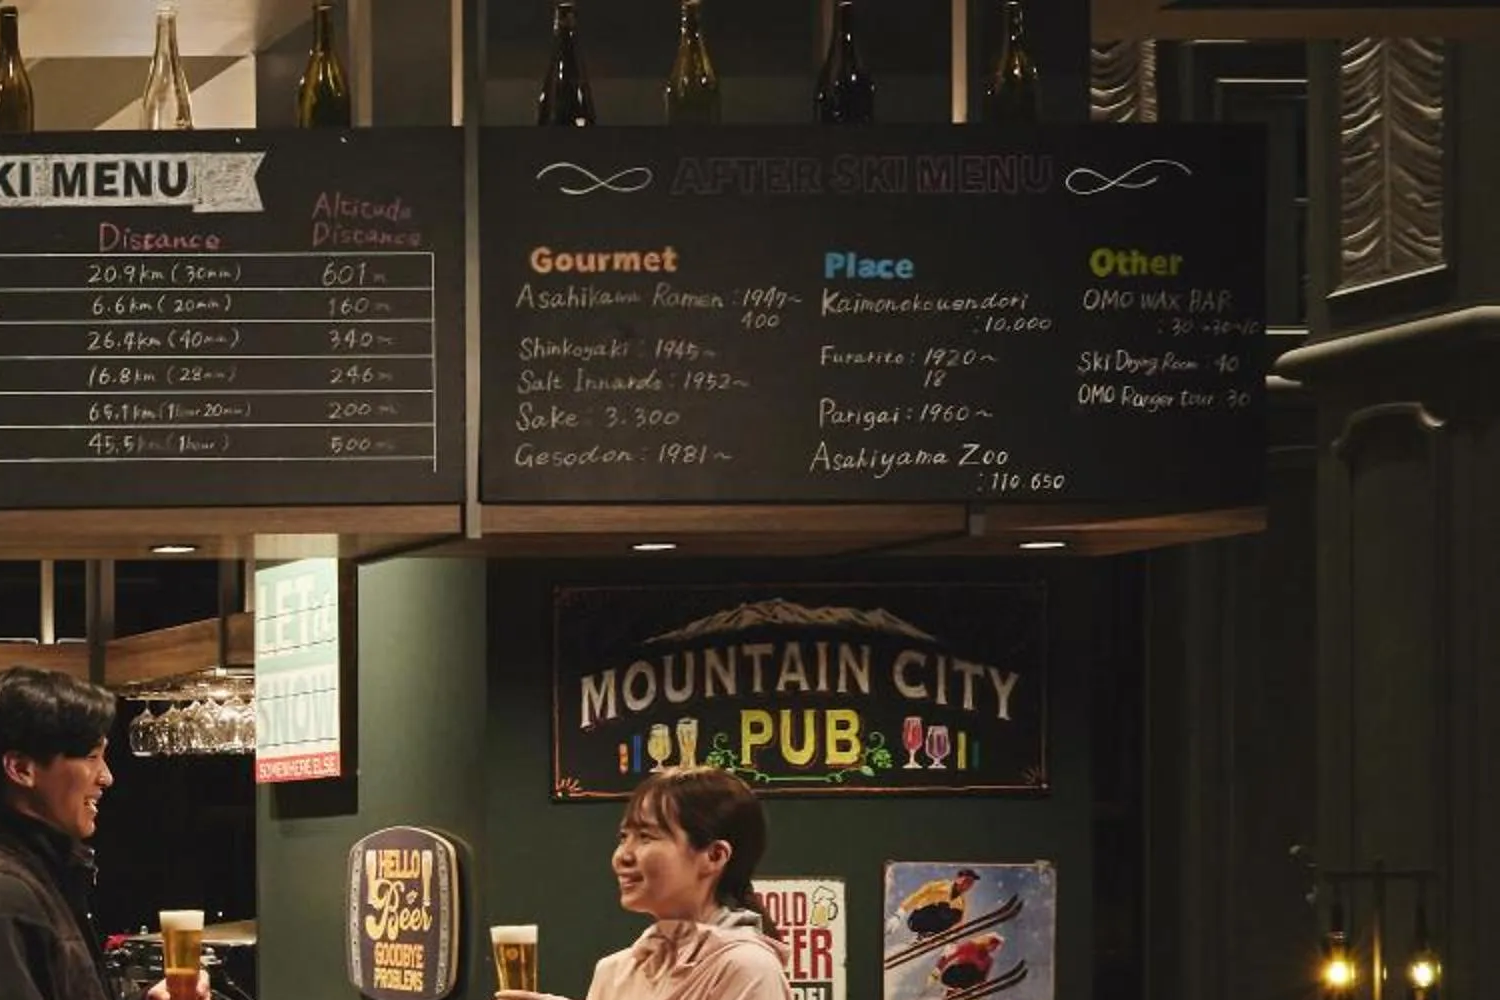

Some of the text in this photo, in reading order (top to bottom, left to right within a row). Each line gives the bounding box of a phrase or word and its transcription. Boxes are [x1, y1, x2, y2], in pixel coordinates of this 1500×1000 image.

[53, 161, 189, 198] MENU
[669, 153, 1054, 195] AFTER SKI MENU
[99, 222, 222, 251] Distance
[311, 221, 422, 247] Distance
[530, 246, 679, 273] Gourmet
[823, 252, 915, 280] Place
[1088, 247, 1184, 278] Other
[958, 443, 1011, 467] Zoo
[579, 641, 1022, 729] MOUNTAIN CITY
[738, 708, 864, 767] PUB
[377, 849, 422, 879] HELLO
[365, 879, 433, 940] Beer
[373, 942, 426, 969] GOODBYE
[373, 967, 425, 993] PROBLEMS
